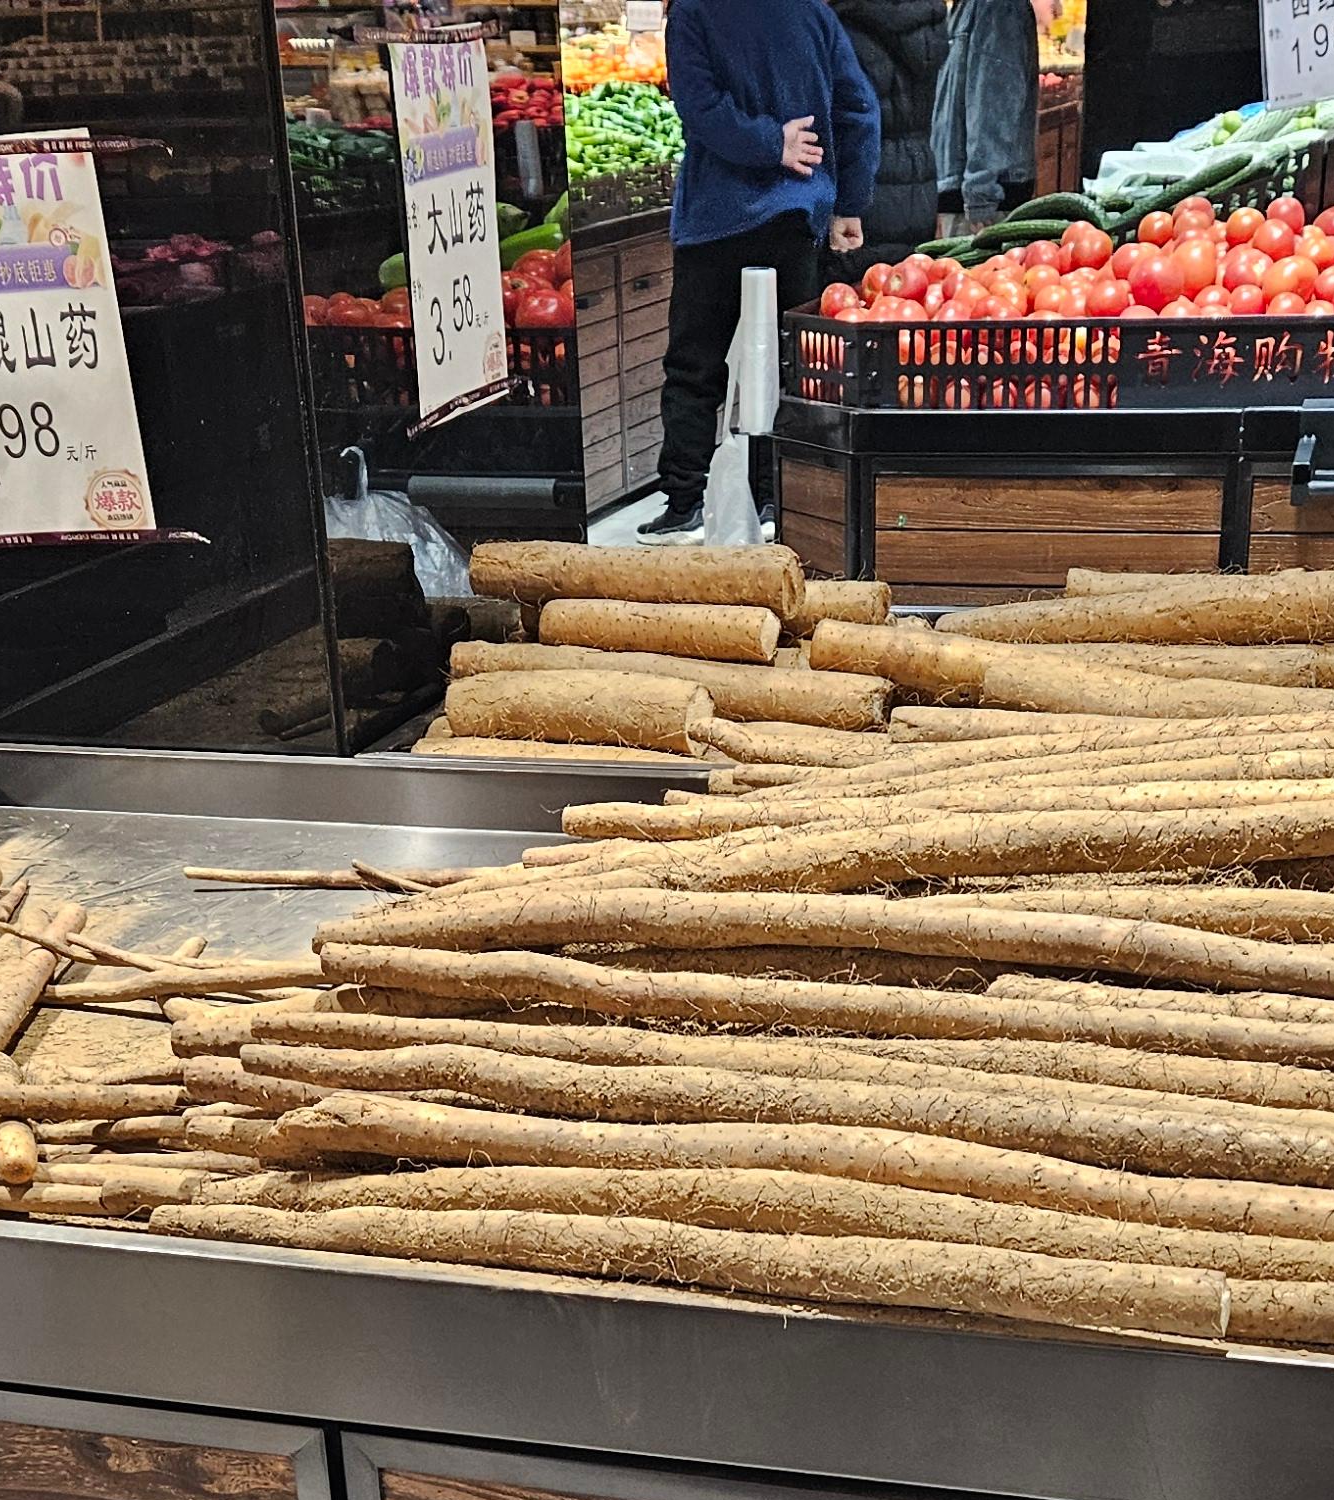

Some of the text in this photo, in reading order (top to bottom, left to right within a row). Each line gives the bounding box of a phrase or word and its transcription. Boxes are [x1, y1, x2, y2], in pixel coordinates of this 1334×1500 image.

[428, 181, 486, 254] 大山药
[430, 274, 474, 365] 3.58
[66, 441, 97, 464] 元/斤
[94, 489, 141, 512] 爆款
